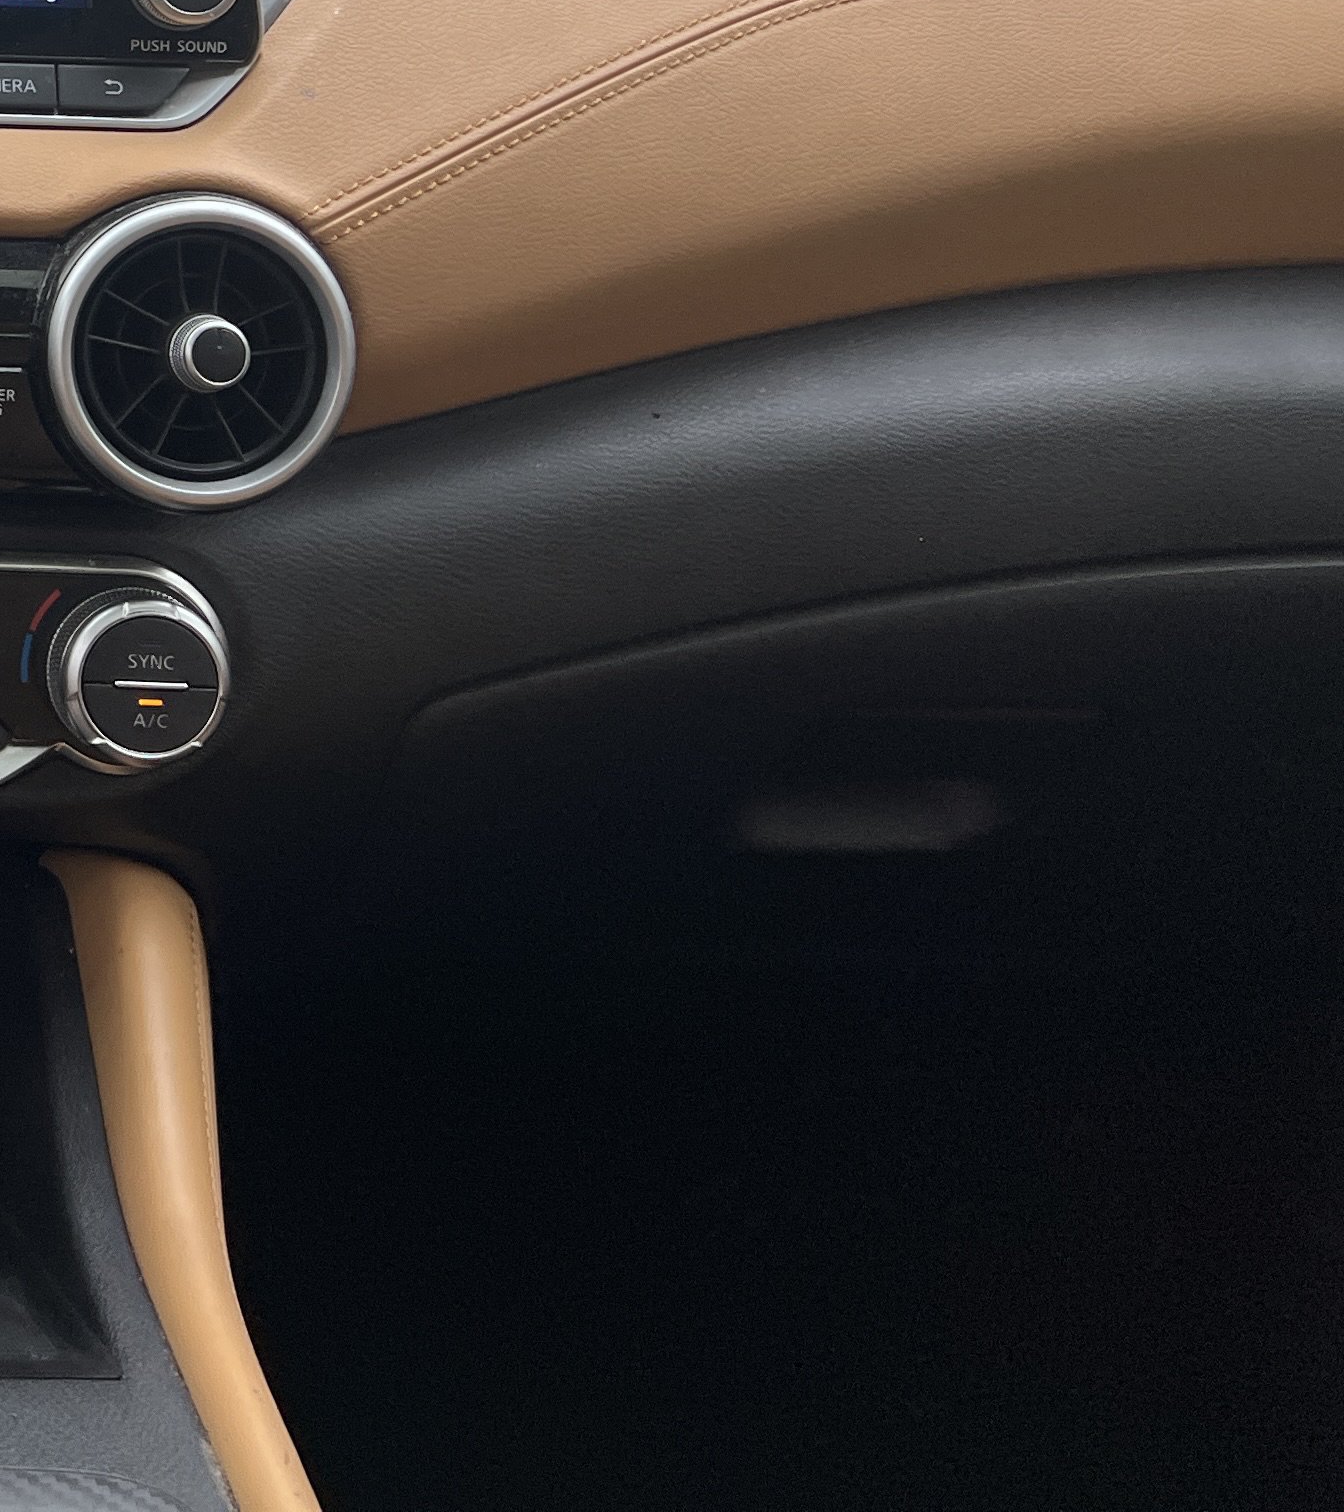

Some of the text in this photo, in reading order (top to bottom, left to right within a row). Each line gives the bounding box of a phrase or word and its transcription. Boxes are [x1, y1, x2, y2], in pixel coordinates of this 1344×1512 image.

[129, 39, 228, 55] PUSH SOUND
[127, 654, 175, 672] SYNC
[133, 713, 169, 730] A/C
